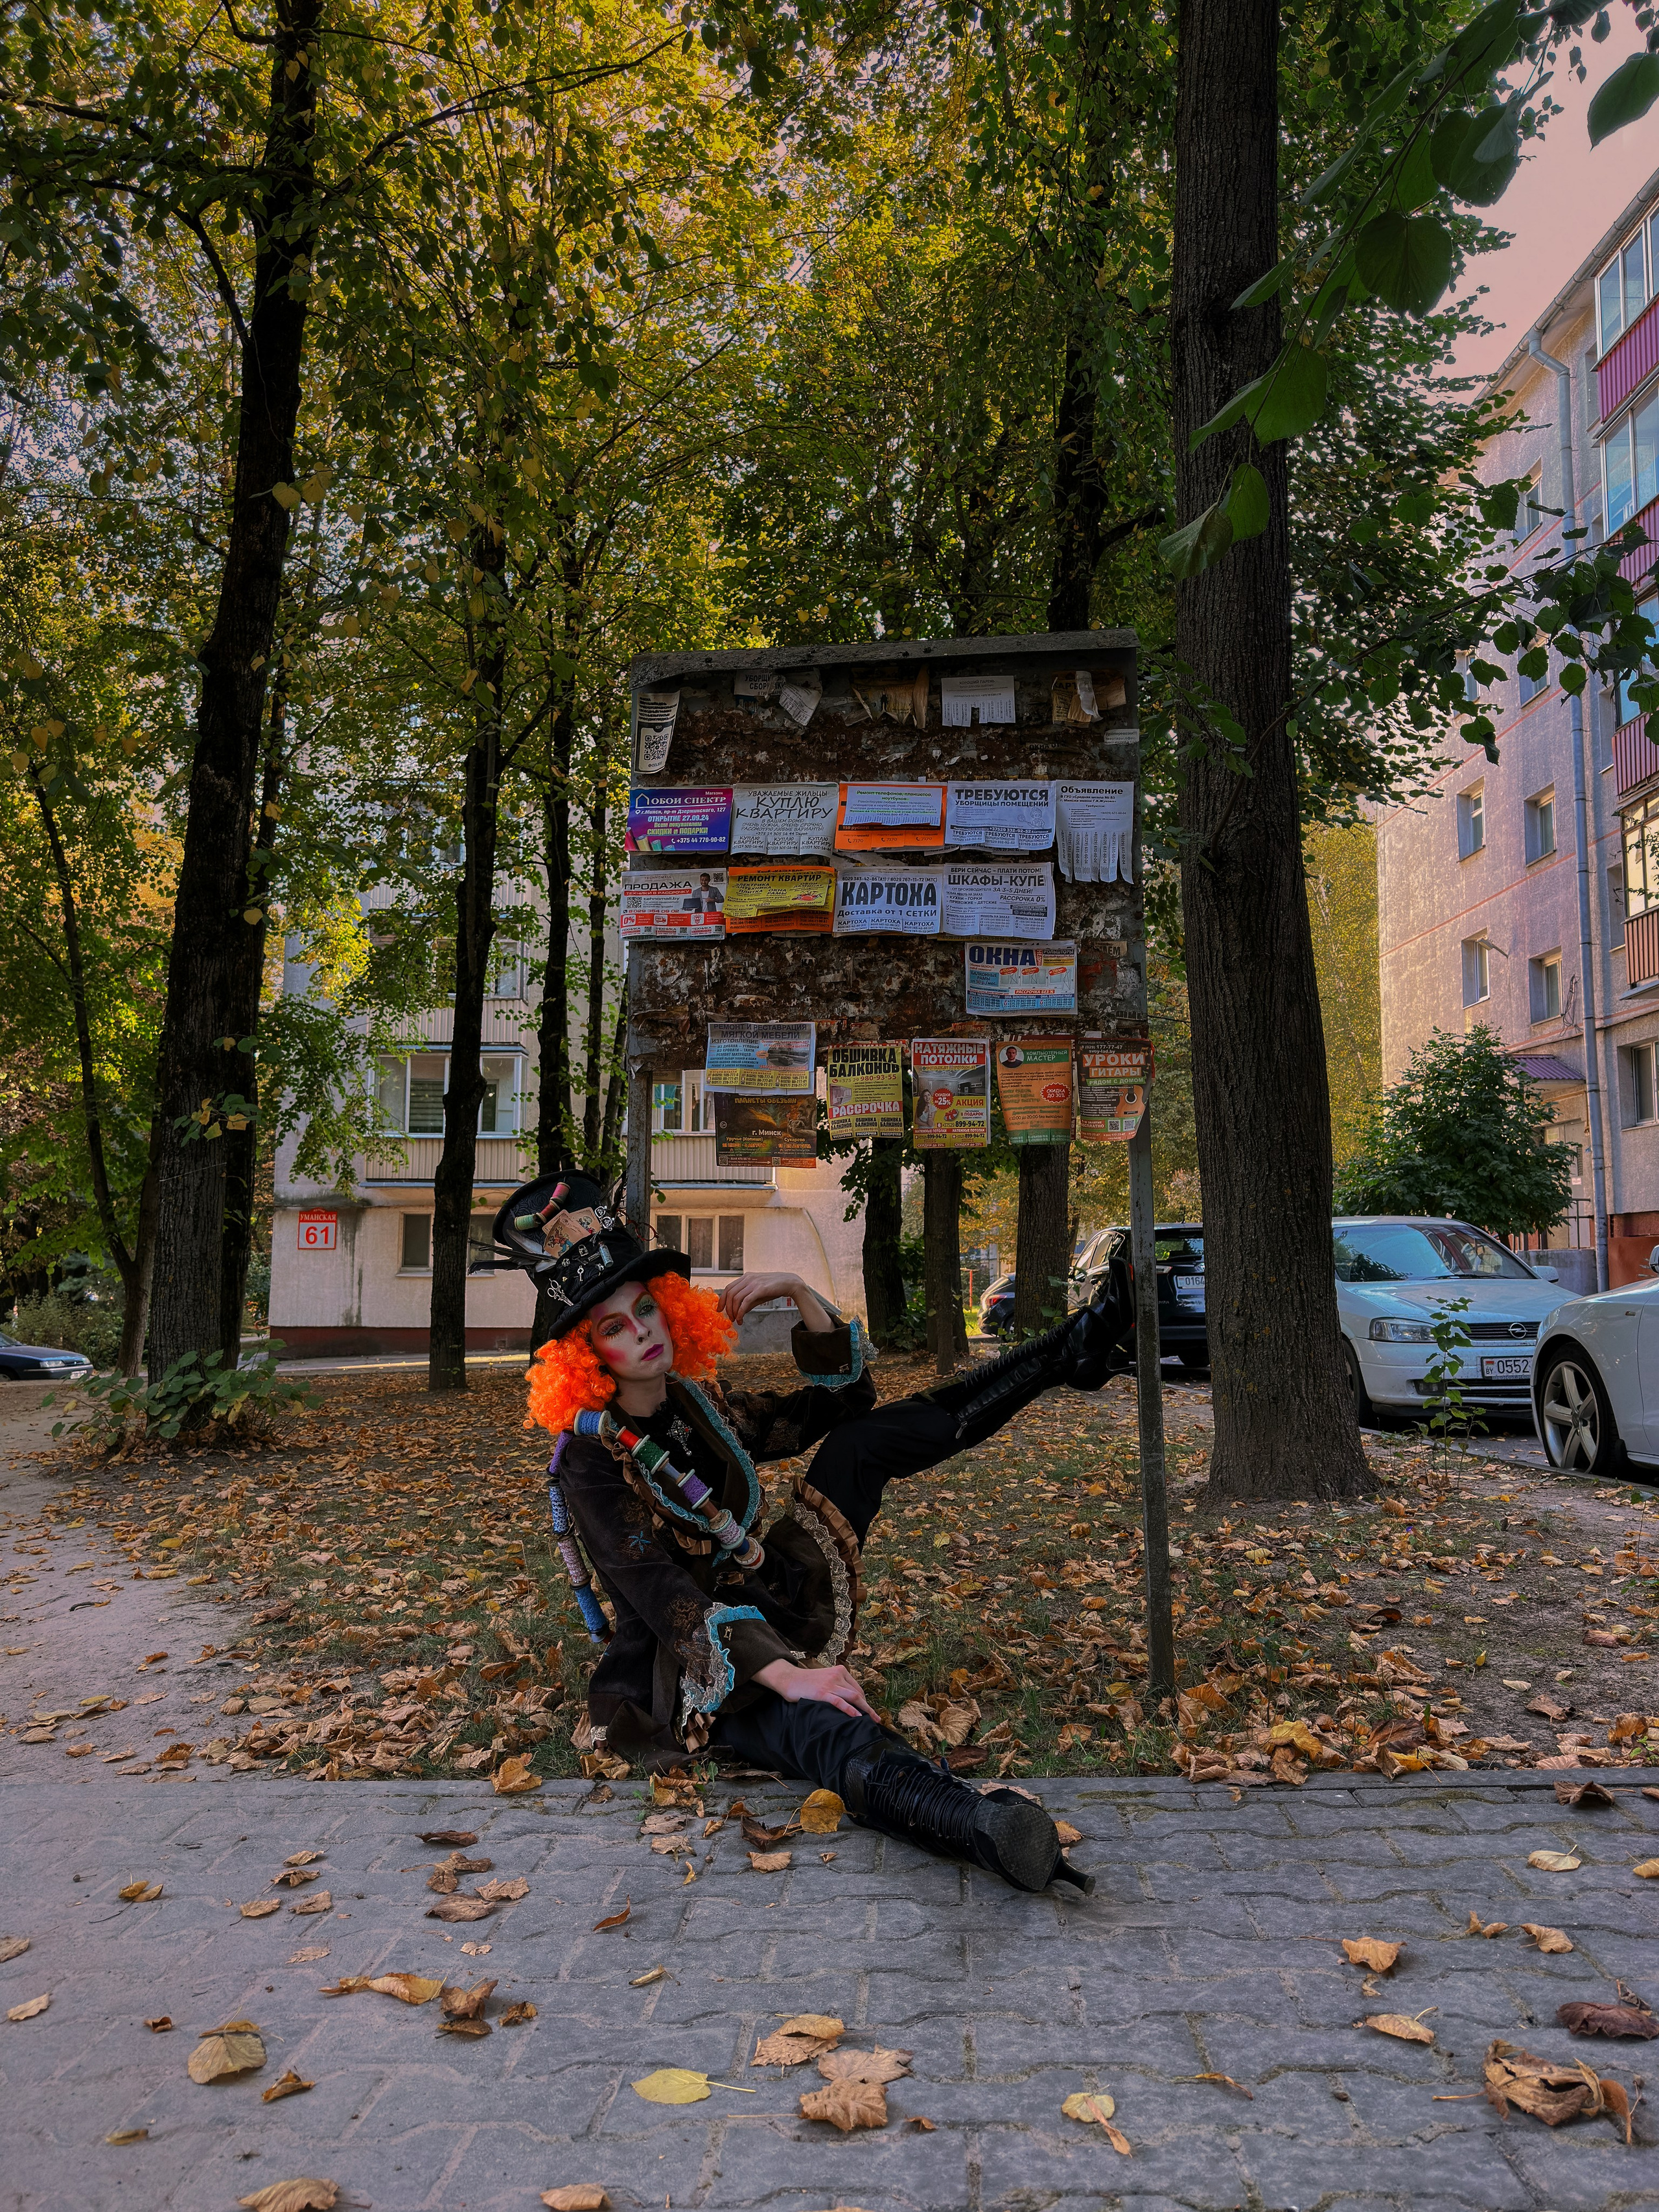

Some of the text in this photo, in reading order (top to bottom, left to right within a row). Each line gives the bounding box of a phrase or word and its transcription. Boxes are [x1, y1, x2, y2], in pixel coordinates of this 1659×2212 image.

[955, 789, 1049, 801] ТРЕБУЮТСЯ
[756, 797, 820, 808] КУПЛЮ
[736, 808, 833, 819] КВАРТИРУ
[625, 881, 692, 891] ПРОДАЖА
[948, 875, 1045, 886] ШКАФЫ-КУПЕ
[841, 882, 936, 907] КАРТОХА
[837, 909, 882, 918] Доставка
[969, 946, 1036, 966] ОКНА
[914, 1043, 984, 1054] НАТЯЖНЫЕ
[833, 1048, 897, 1063] ОБШИВКА
[921, 1054, 977, 1064] ПОТОЛКИ
[1084, 1054, 1145, 1067] УРОКИ
[830, 1062, 899, 1077] БАЛКОНОВ
[1091, 1067, 1140, 1077] ГИТАРЫ
[833, 1101, 900, 1117] РАССРОЧКА
[956, 1099, 984, 1108] АКЦИЯ
[306, 1226, 329, 1244] 61
[1498, 1359, 1529, 1373] 0552
